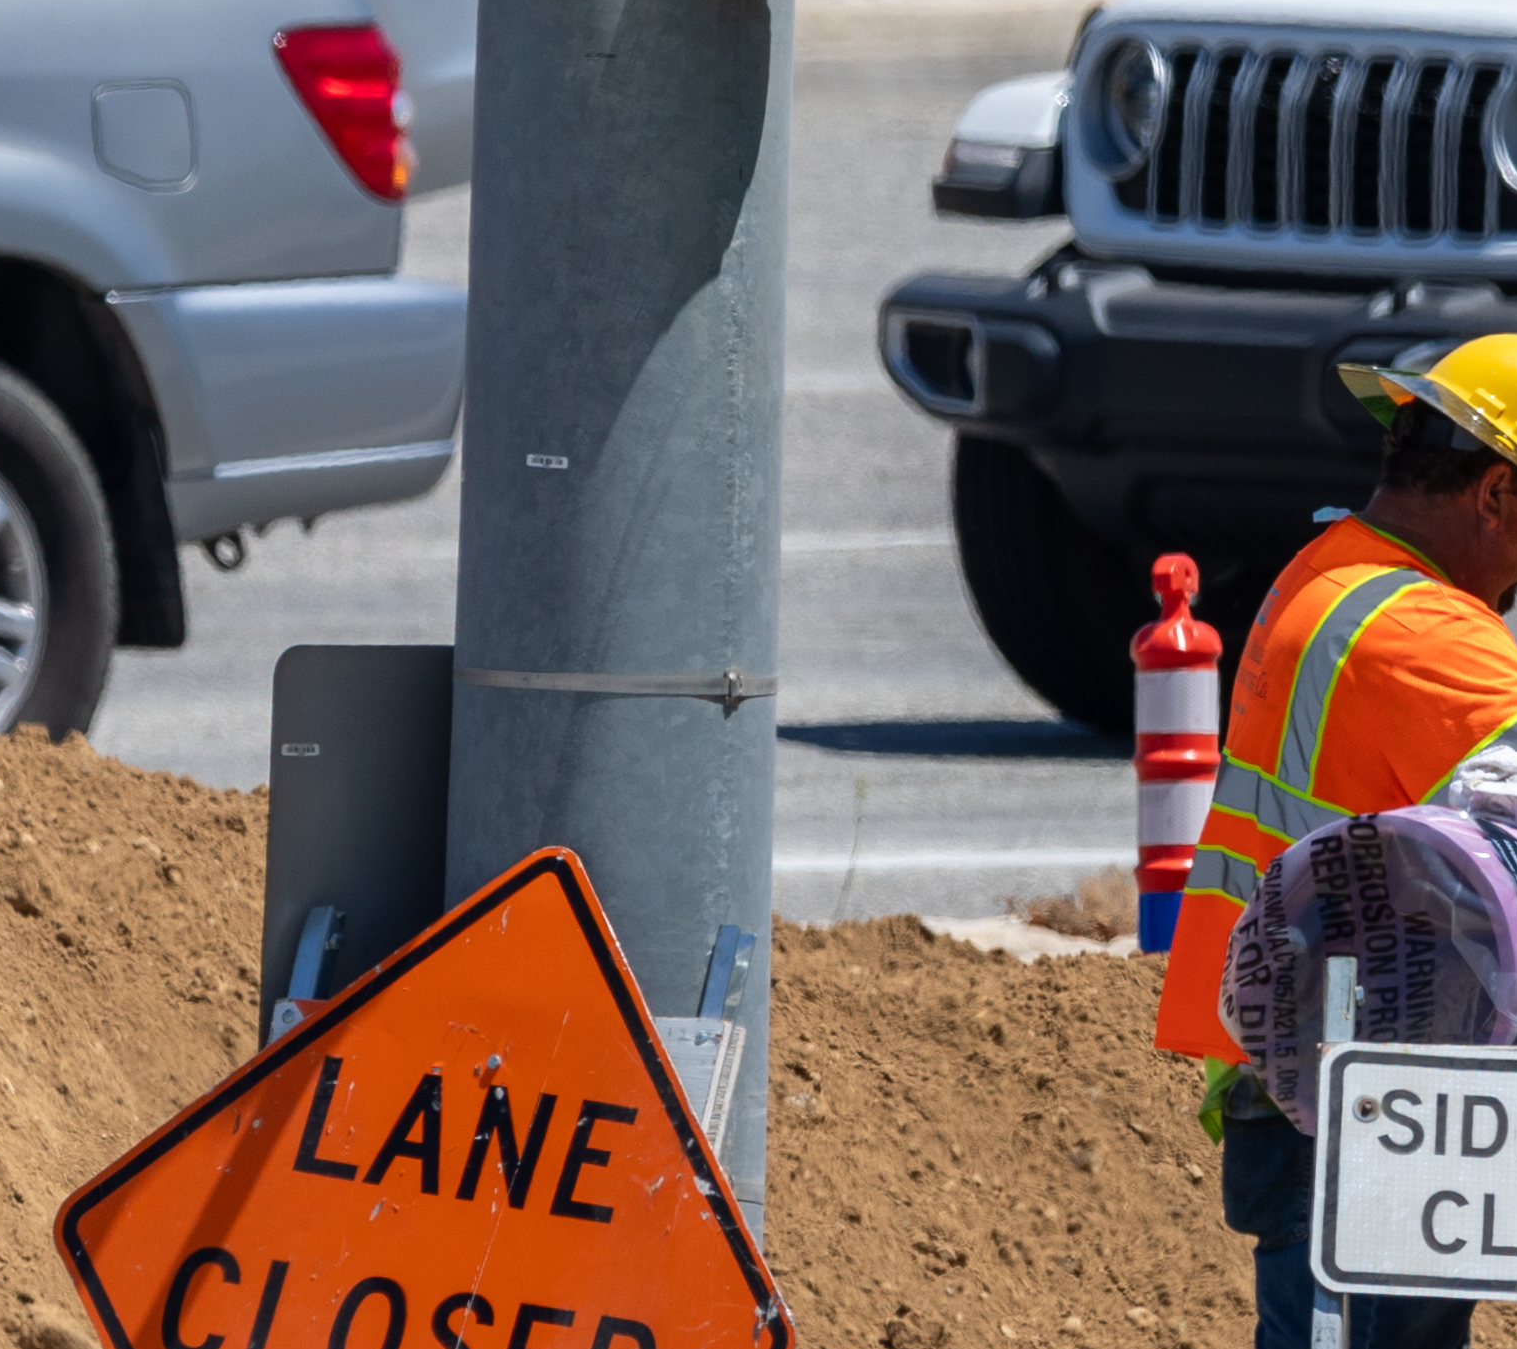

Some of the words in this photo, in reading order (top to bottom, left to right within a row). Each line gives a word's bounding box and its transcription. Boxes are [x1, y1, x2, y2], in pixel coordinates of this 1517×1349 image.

[1310, 834, 1358, 942] REPAIR
[1234, 917, 1273, 990] FOR
[292, 1055, 639, 1224] LANE
